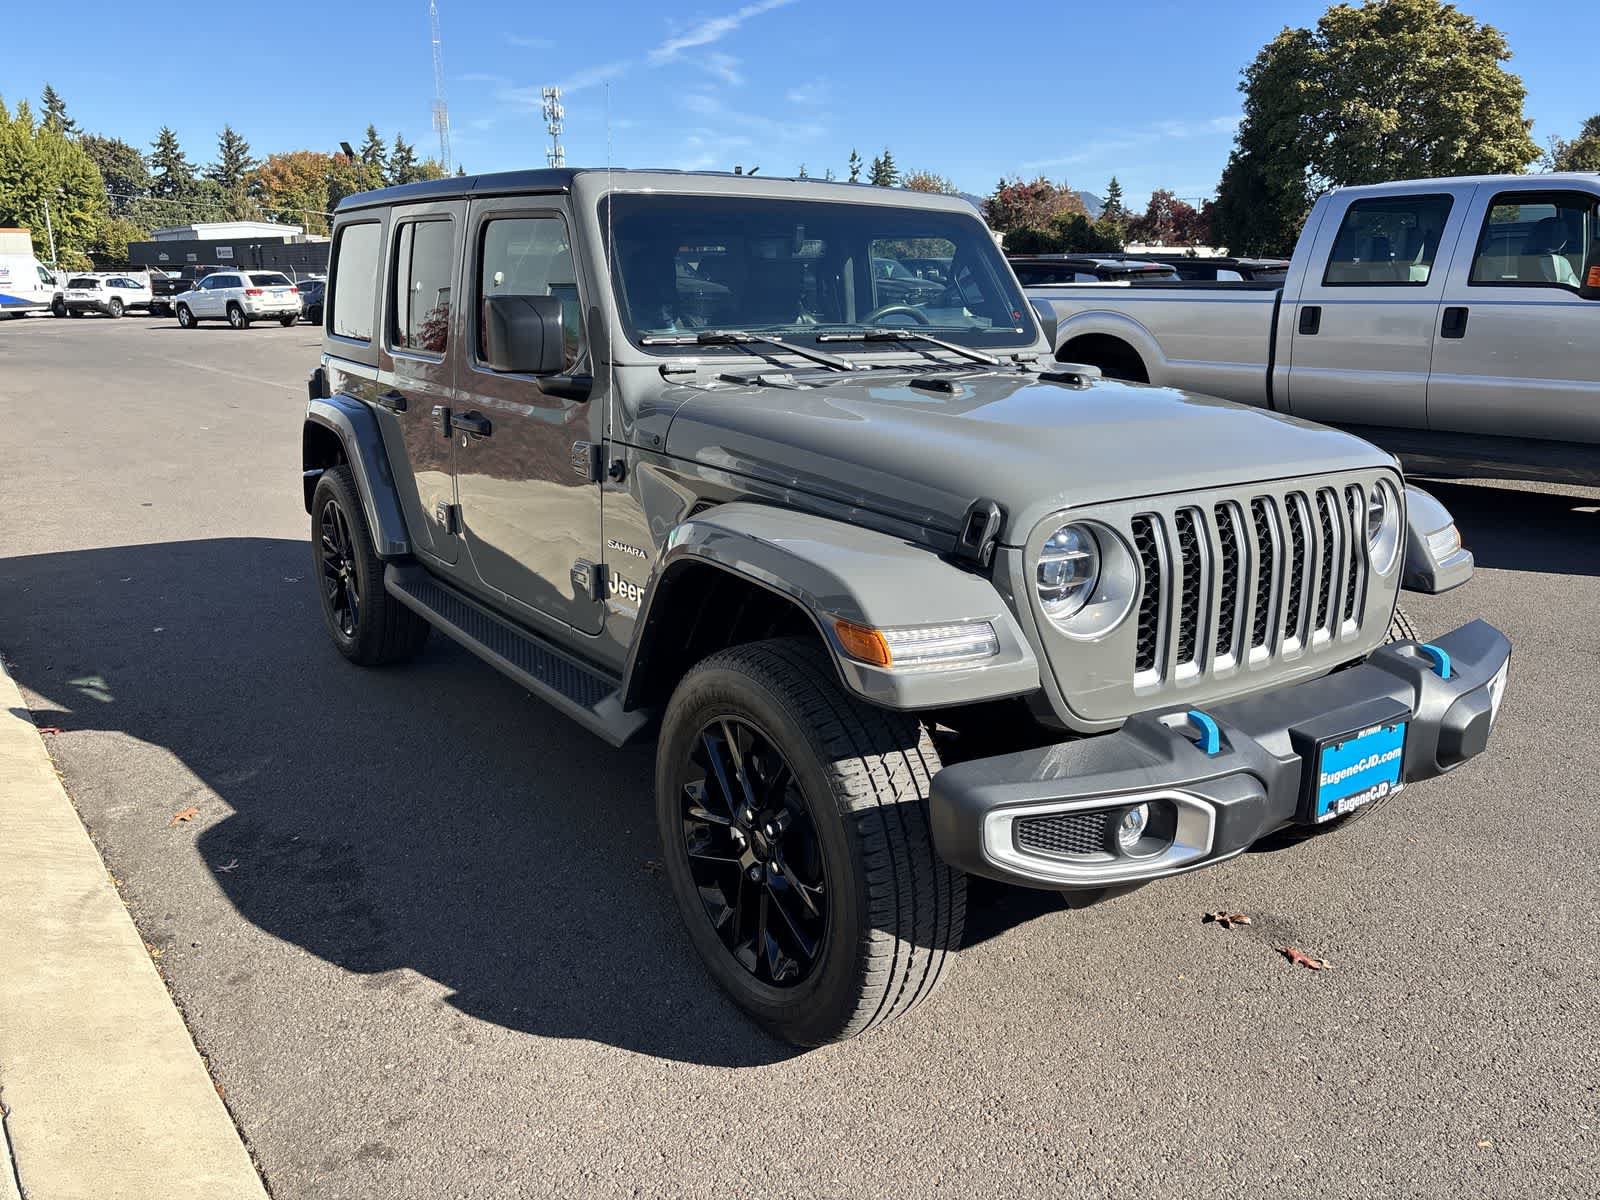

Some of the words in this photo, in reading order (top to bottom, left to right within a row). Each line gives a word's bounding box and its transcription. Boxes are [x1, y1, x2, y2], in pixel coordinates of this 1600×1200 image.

[607, 540, 648, 560] SAHARA
[608, 572, 645, 608] Jeep
[1320, 747, 1402, 787] EugeneCJD.com
[1337, 782, 1389, 813] EugeneCJD
